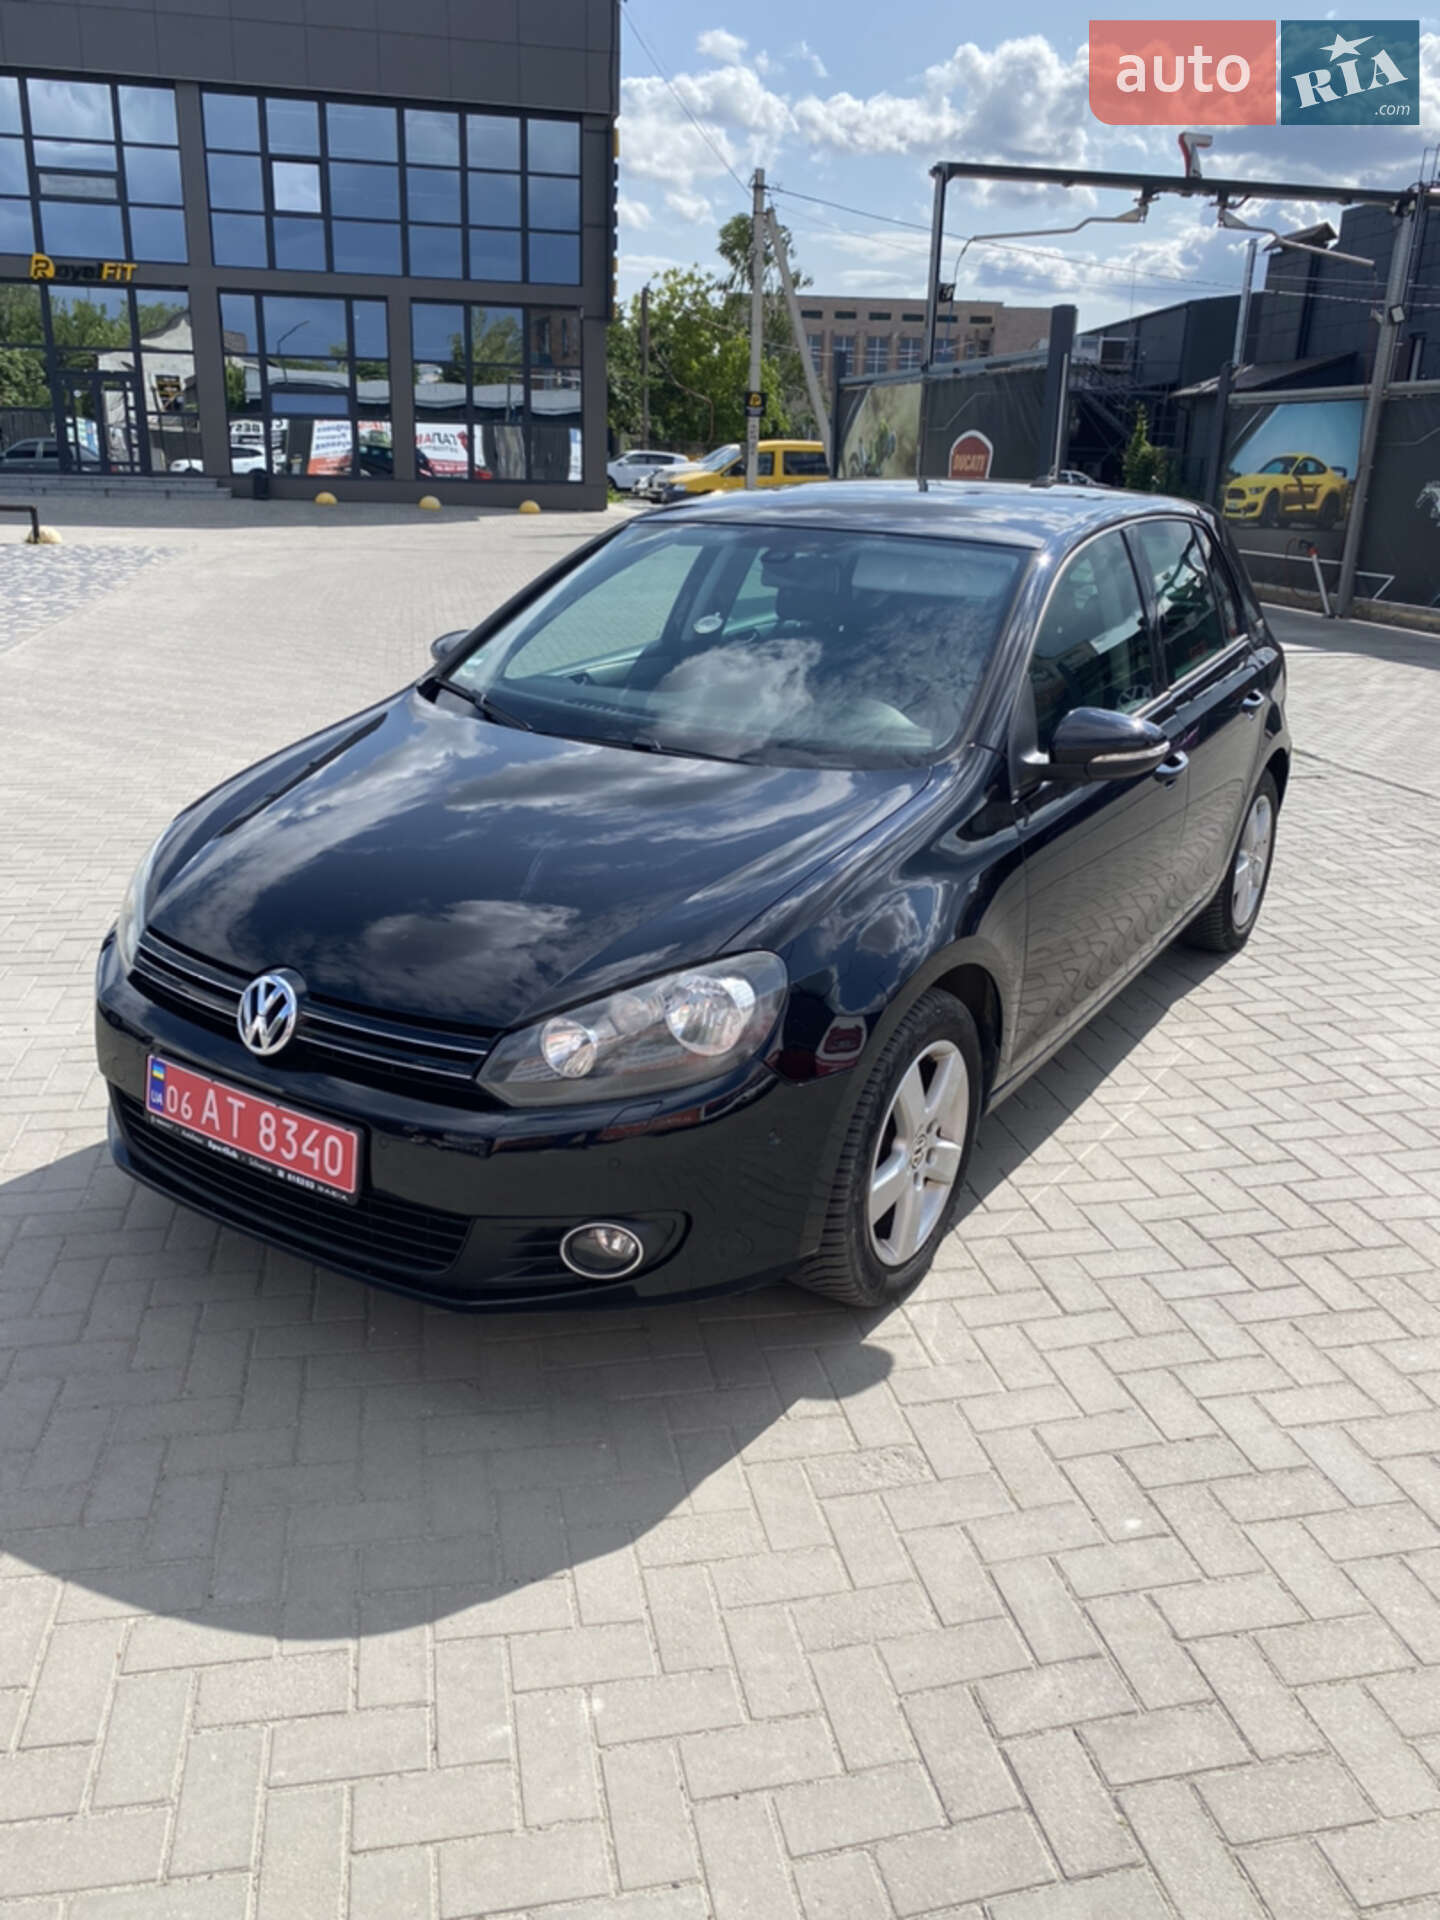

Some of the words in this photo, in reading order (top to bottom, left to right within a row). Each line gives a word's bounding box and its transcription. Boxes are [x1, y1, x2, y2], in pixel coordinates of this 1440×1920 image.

[952, 453, 986, 472] DUCATI
[166, 1085, 193, 1121] 06
[201, 1087, 246, 1139] AT
[259, 1111, 343, 1177] 8340
